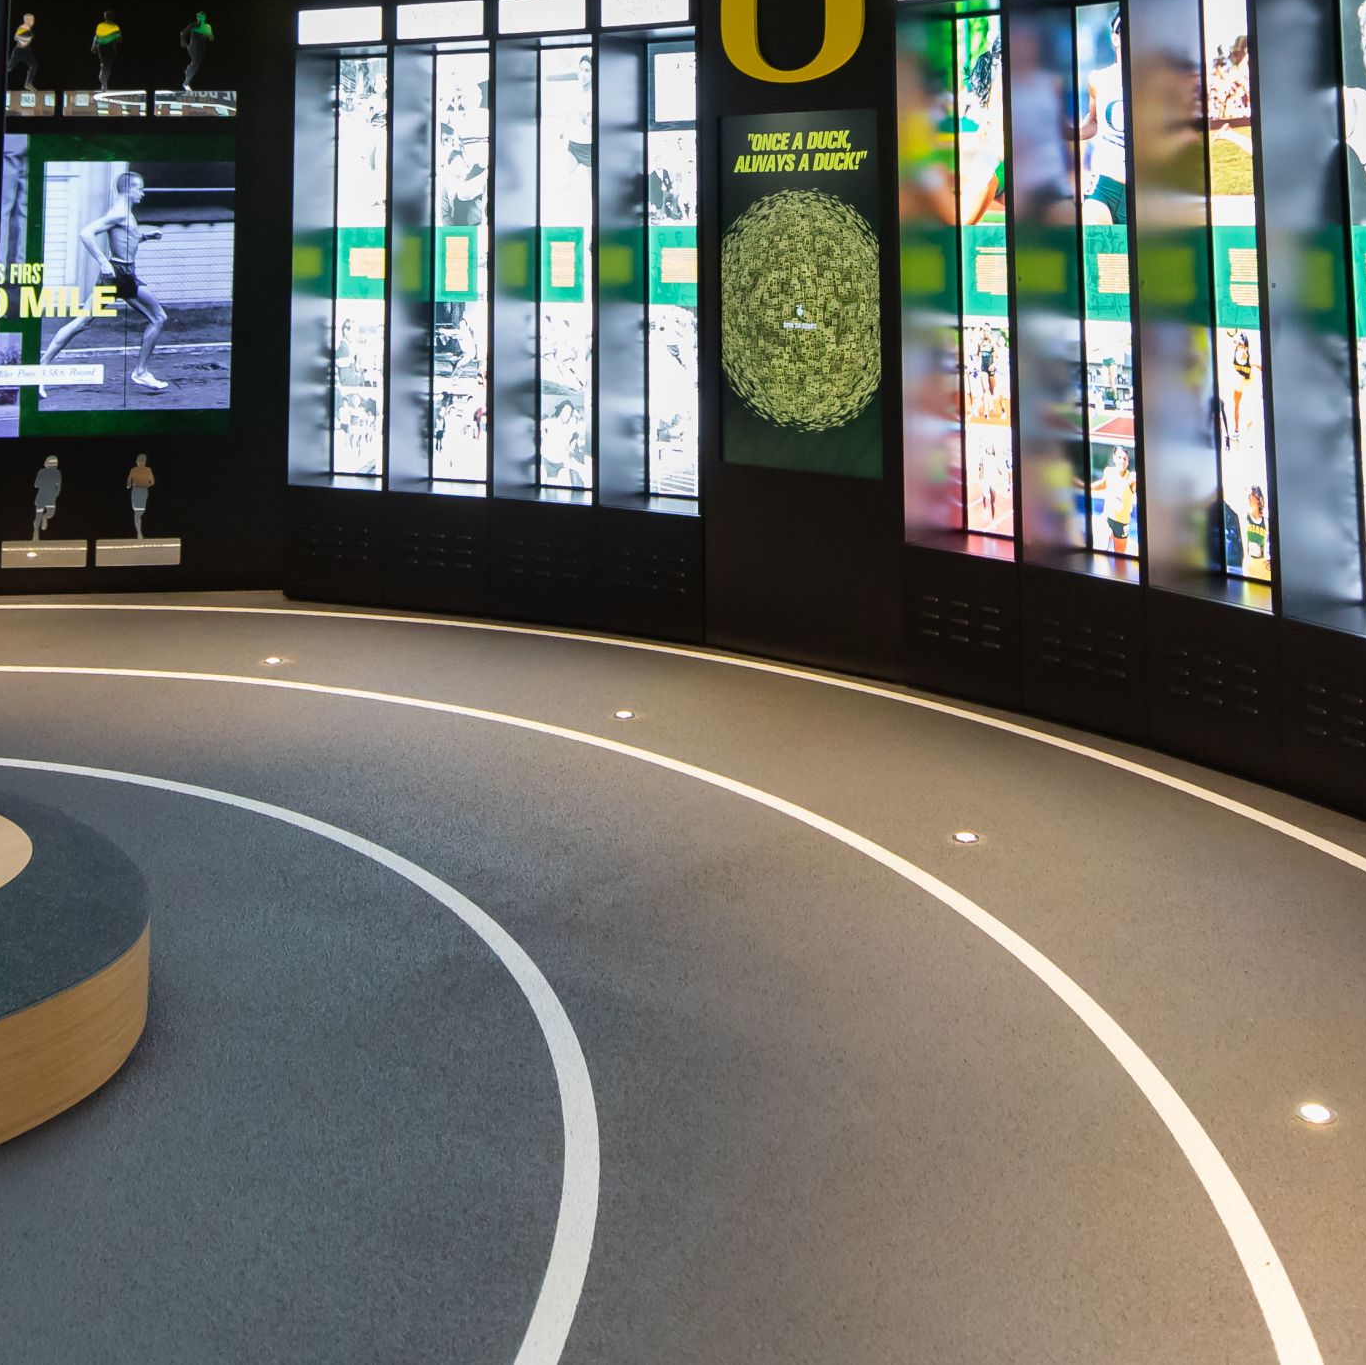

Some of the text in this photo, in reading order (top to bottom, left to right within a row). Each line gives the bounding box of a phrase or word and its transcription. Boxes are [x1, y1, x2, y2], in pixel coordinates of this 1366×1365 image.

[747, 129, 852, 152] "ONCE A DUCK,
[734, 151, 868, 173] ALWAYS A DUCK!"
[19, 285, 118, 319] MILE
[69, 367, 96, 378] Record
